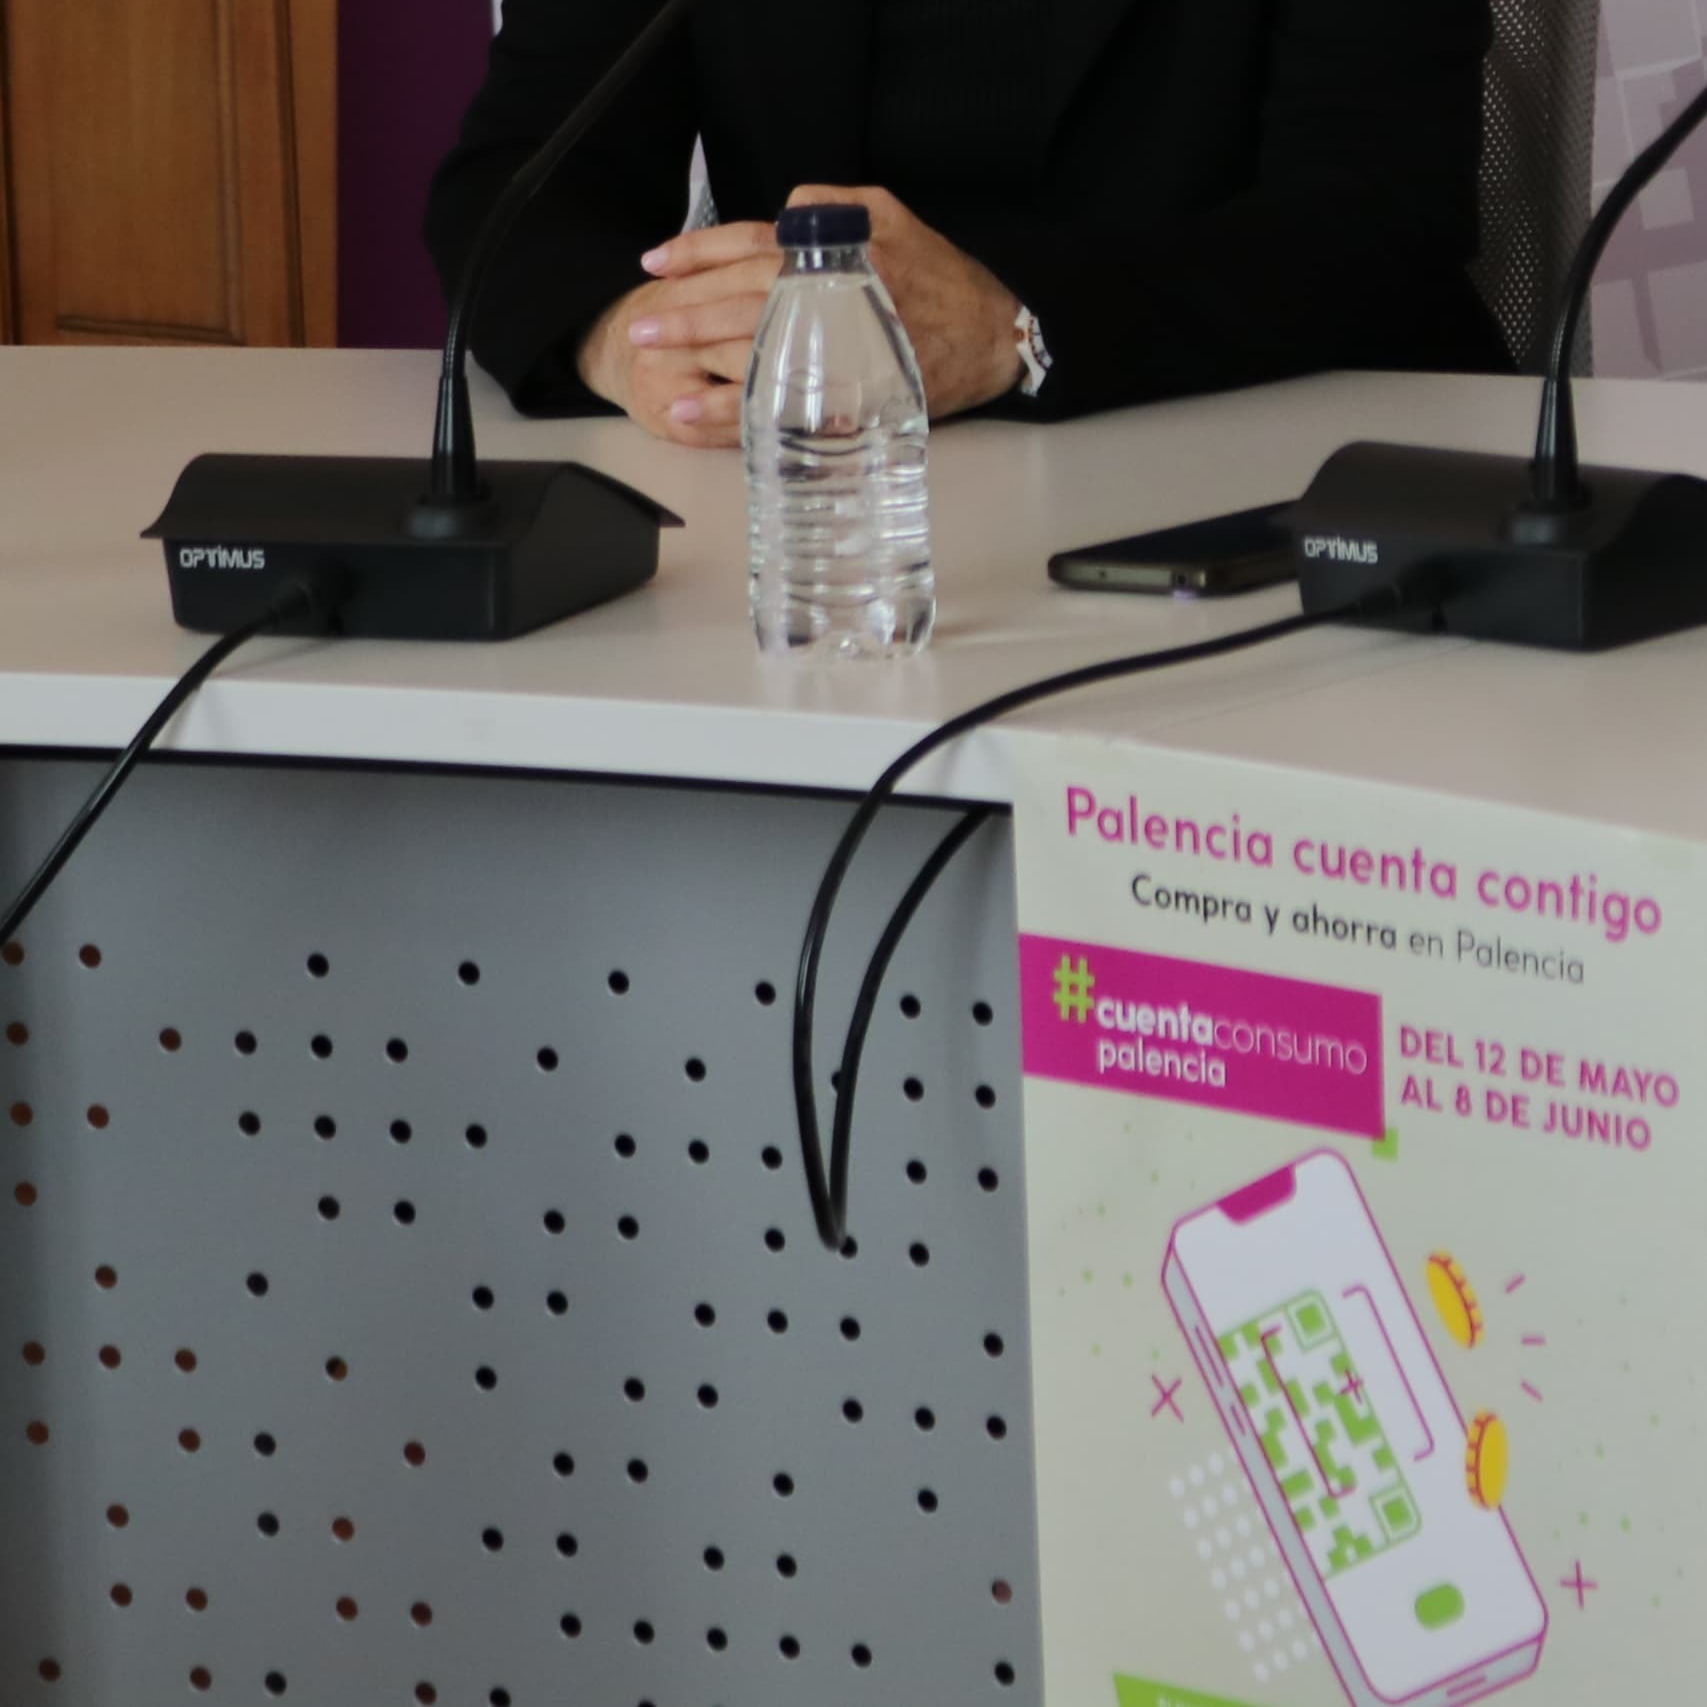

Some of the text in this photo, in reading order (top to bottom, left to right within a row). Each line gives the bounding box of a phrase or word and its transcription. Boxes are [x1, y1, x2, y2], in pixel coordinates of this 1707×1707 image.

[1067, 786, 1661, 941] Palencia cuenta contigo
[1131, 873, 1584, 983] Compra y ahorra en Palencia
[1097, 1036, 1227, 1088] palencia
[1400, 1025, 1679, 1108] DEL 12 DE MAYO
[1401, 1075, 1652, 1151] AL 8 DE JUNIO
